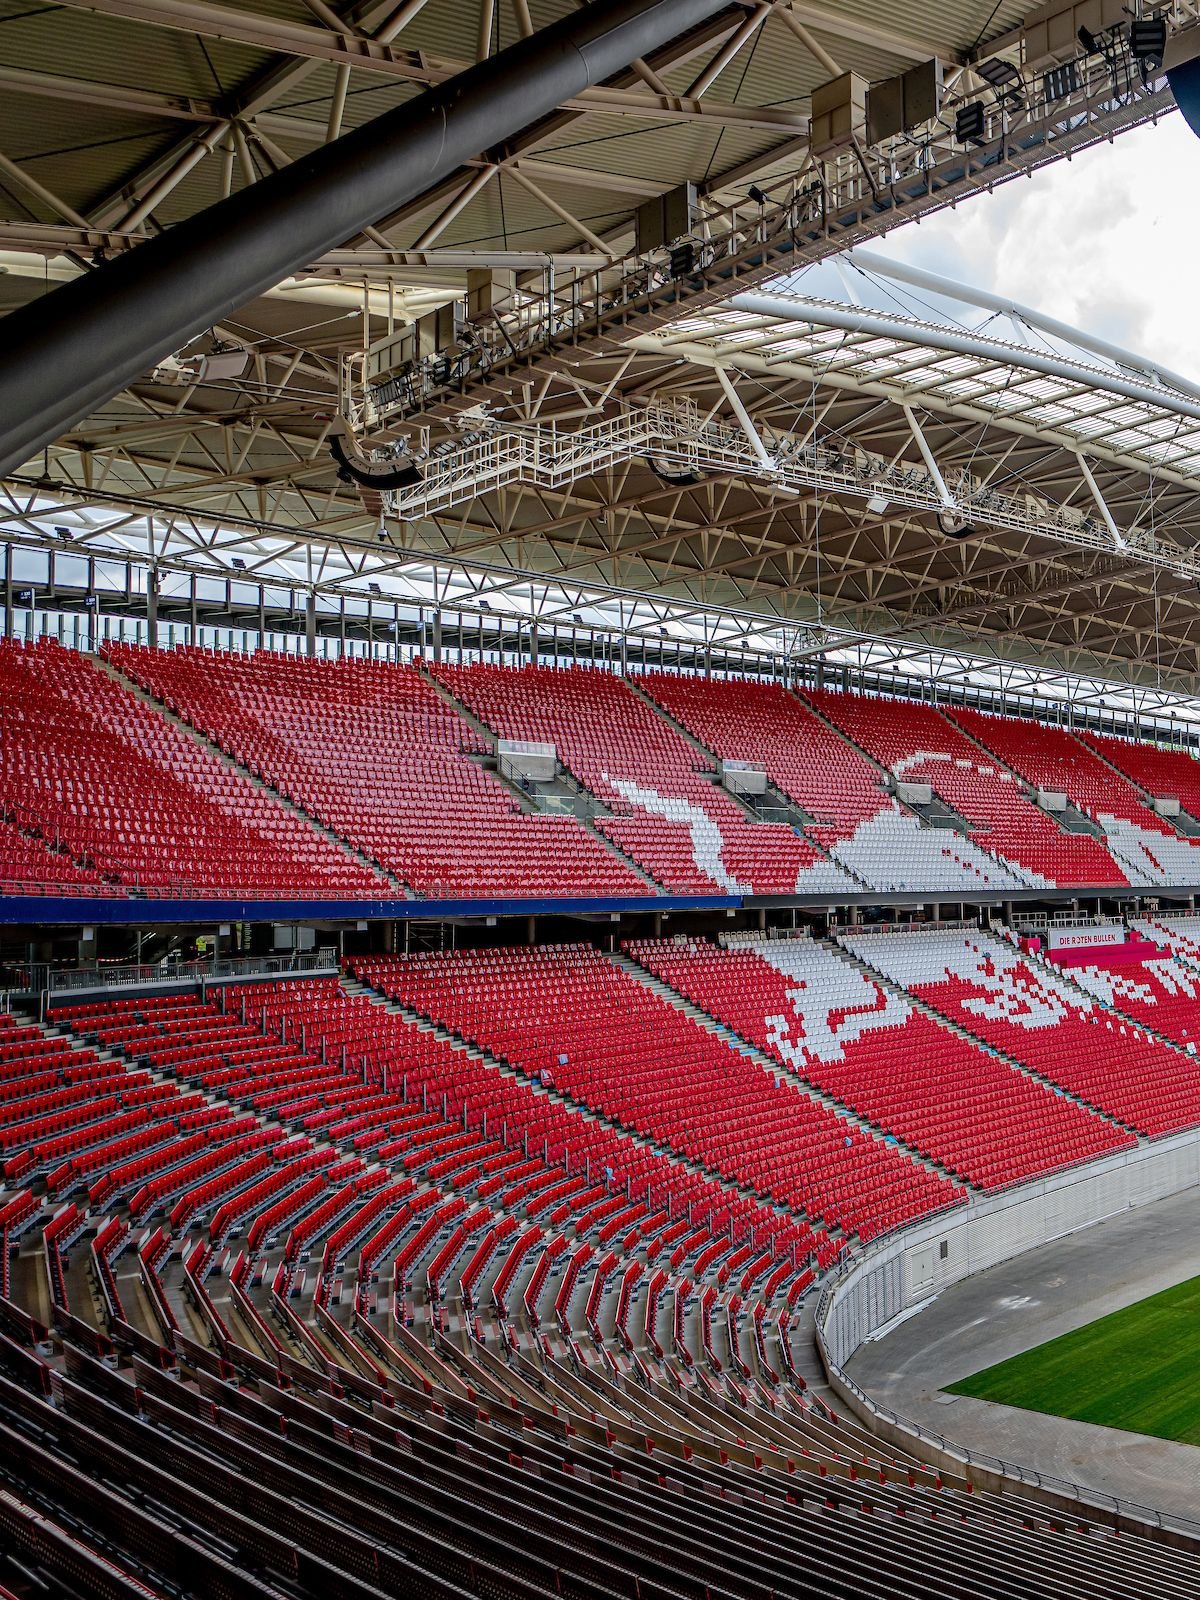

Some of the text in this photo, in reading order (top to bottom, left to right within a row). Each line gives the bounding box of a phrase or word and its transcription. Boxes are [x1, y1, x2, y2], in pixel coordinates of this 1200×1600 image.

[1060, 934, 1116, 945] DIE ROTEN BULLEN
